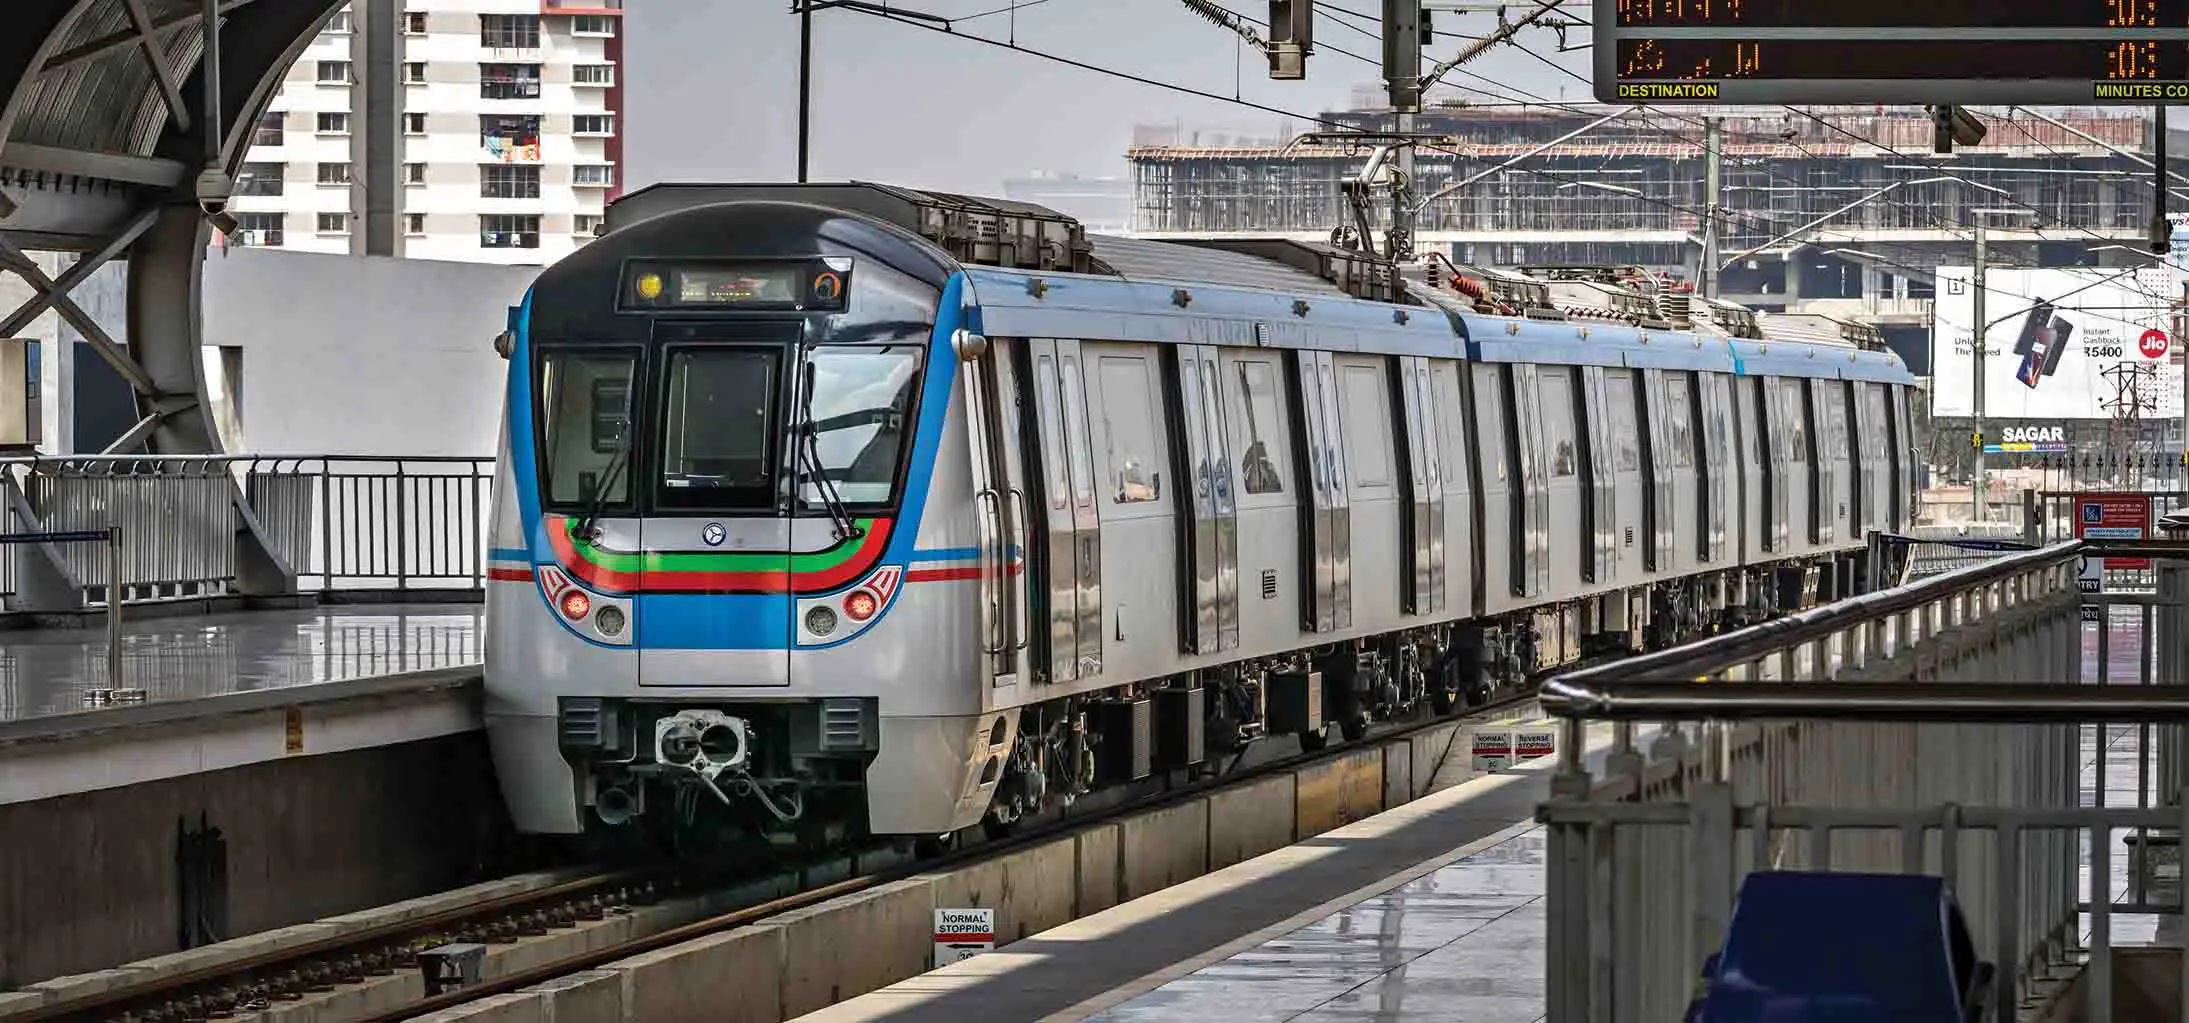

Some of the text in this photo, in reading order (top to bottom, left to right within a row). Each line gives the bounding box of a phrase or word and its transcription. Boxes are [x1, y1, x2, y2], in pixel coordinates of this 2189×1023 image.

[1619, 84, 1718, 97] DESTINATION
[2096, 84, 2162, 97] MINUTES
[2083, 336, 2121, 344] Cashback
[2142, 335, 2166, 350] Jio
[2084, 346, 2122, 357] ₹5400
[2002, 426, 2064, 442] SAGAR
[2080, 581, 2099, 590] TRY
[943, 914, 986, 923] NORMAL
[939, 925, 990, 933] STOPPING
